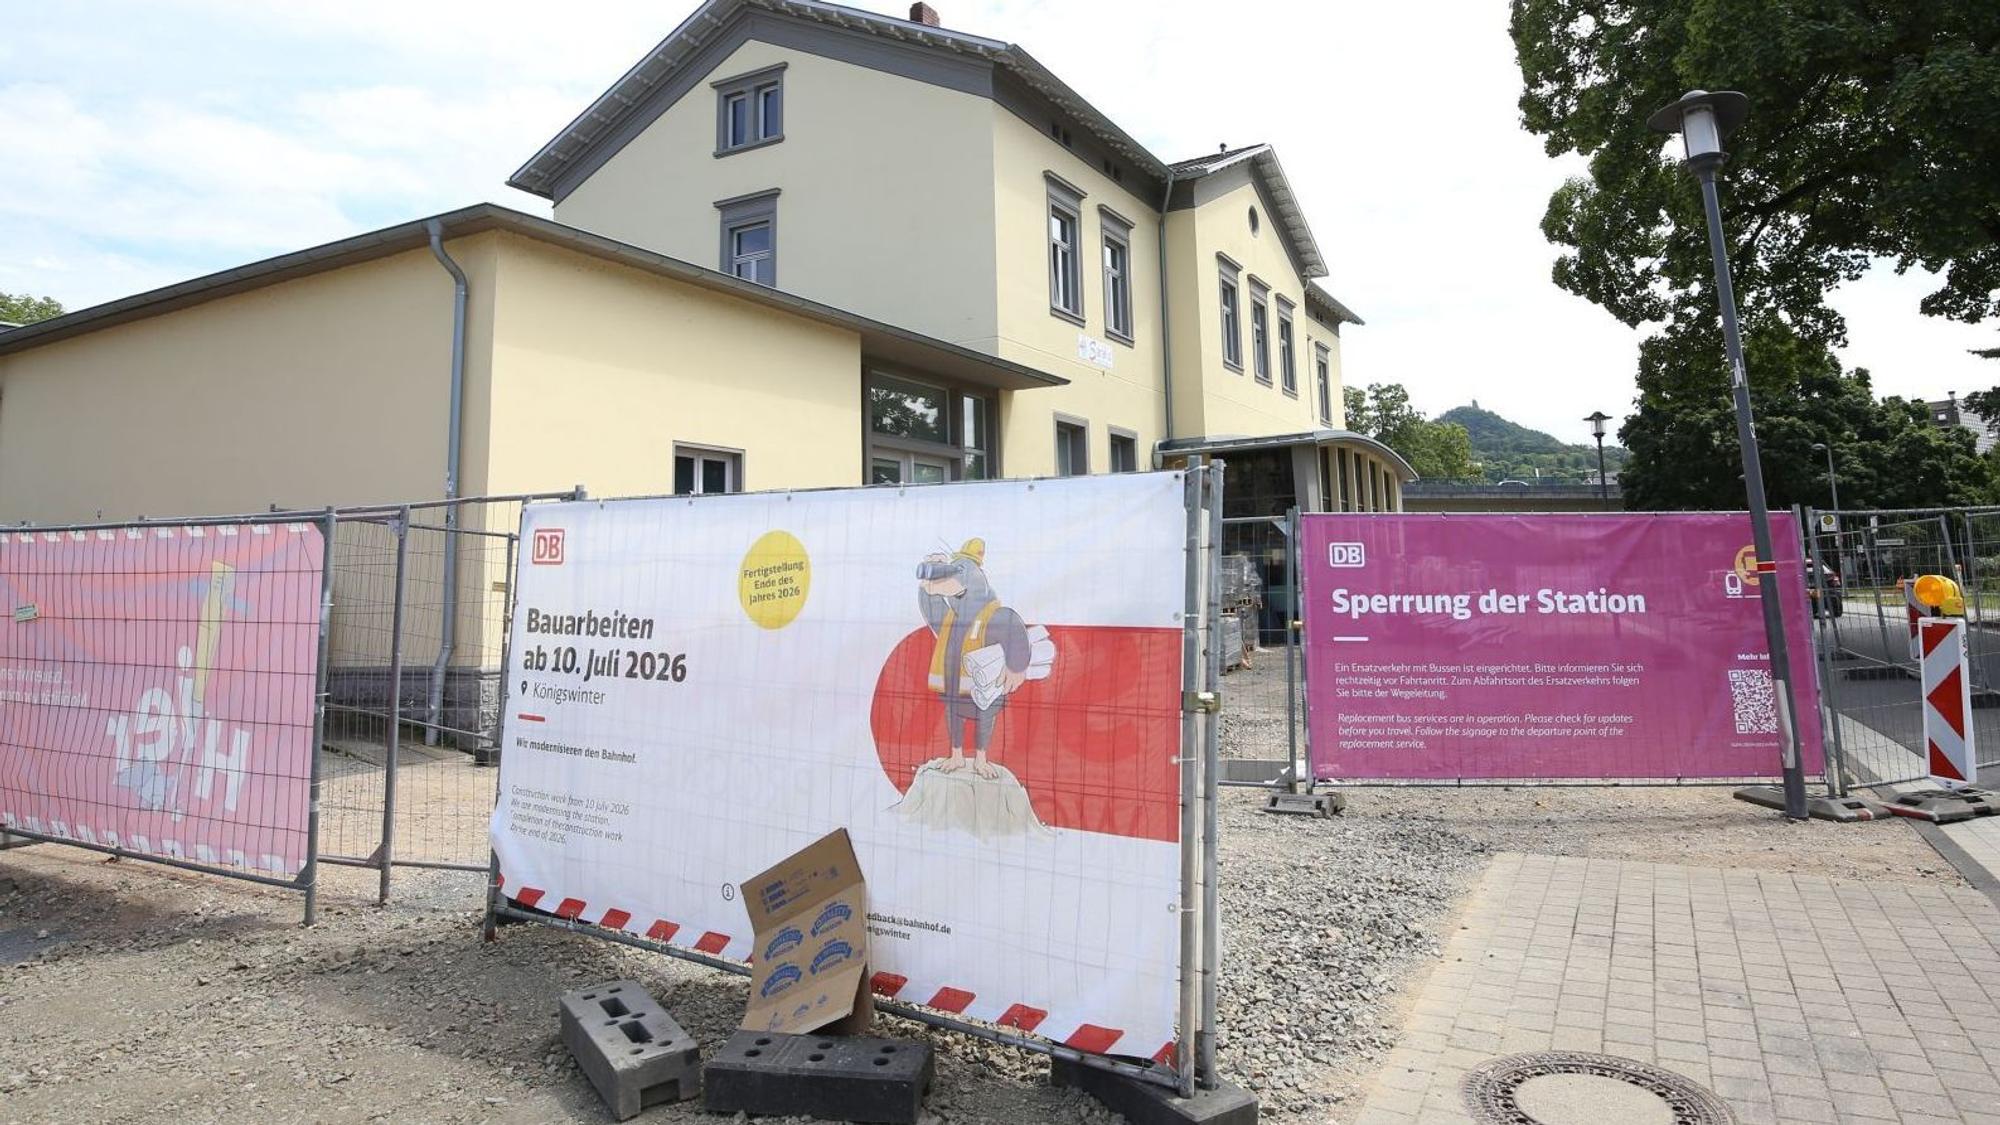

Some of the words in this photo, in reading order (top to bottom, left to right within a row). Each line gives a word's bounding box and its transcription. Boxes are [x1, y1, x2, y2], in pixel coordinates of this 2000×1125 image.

[534, 533, 562, 560] DB
[1332, 545, 1362, 565] DB
[744, 561, 804, 578] Fertigstellung
[754, 579, 776, 590] Ende
[778, 576, 794, 585] des
[749, 592, 776, 605] Jahres
[778, 586, 801, 599] 2026
[1332, 588, 1472, 620] Sperrung
[1478, 588, 1530, 614] der
[1537, 587, 1646, 614] Station
[526, 607, 655, 640] Bauarbeiten
[523, 644, 548, 672] ab
[551, 646, 581, 674] 10.
[583, 649, 620, 682] Juli
[625, 650, 687, 683] 2026
[1737, 653, 1758, 661] Mehr
[1335, 663, 1350, 673] Ein
[1351, 663, 1411, 673] Ersatzverkehr
[1412, 664, 1427, 673] mit
[1429, 664, 1461, 673] Bussen
[1463, 664, 1474, 673] ist
[1476, 664, 1532, 675] eingerichtet.
[1534, 663, 1556, 673] Bitte
[1558, 663, 1609, 673] informieren
[1611, 663, 1625, 673] Sie
[1626, 663, 1644, 673] sich
[1336, 675, 1382, 687] rechtzeitig
[1450, 676, 1471, 686] Zum
[1473, 675, 1526, 686] Abfahrtsort
[1527, 676, 1544, 686] des
[1545, 675, 1611, 686] Ersatzverkehrs
[1612, 675, 1640, 687] folgen
[532, 681, 606, 705] Königswinter
[1336, 688, 1350, 697] Sie
[1352, 688, 1373, 697] bitte
[1374, 688, 1389, 697] der
[1338, 713, 1394, 724] Replacement
[1396, 714, 1412, 723] bus
[1414, 714, 1447, 723] services
[1466, 714, 1475, 723] in
[1476, 714, 1522, 725] operation.
[1524, 714, 1552, 723] Please
[1554, 714, 1582, 723] check
[1583, 714, 1596, 725] for
[1598, 714, 1633, 725] updates
[1338, 726, 1367, 737] before
[1368, 728, 1386, 738] you
[1415, 726, 1443, 736] Follow
[1445, 726, 1460, 736] the
[1462, 727, 1499, 738] signage
[1500, 727, 1509, 736] to
[1510, 726, 1525, 736] the
[1527, 726, 1572, 737] departure
[1573, 726, 1597, 737] point
[1598, 726, 1609, 737] of
[1609, 726, 1624, 736] the
[530, 741, 583, 756] modernisieren
[585, 747, 600, 758] den
[1339, 739, 1395, 749] replacement
[1396, 739, 1427, 749] service.
[610, 803, 630, 815] 2026
[605, 831, 624, 842] work
[866, 912, 952, 934] edback@bahnhof.de
